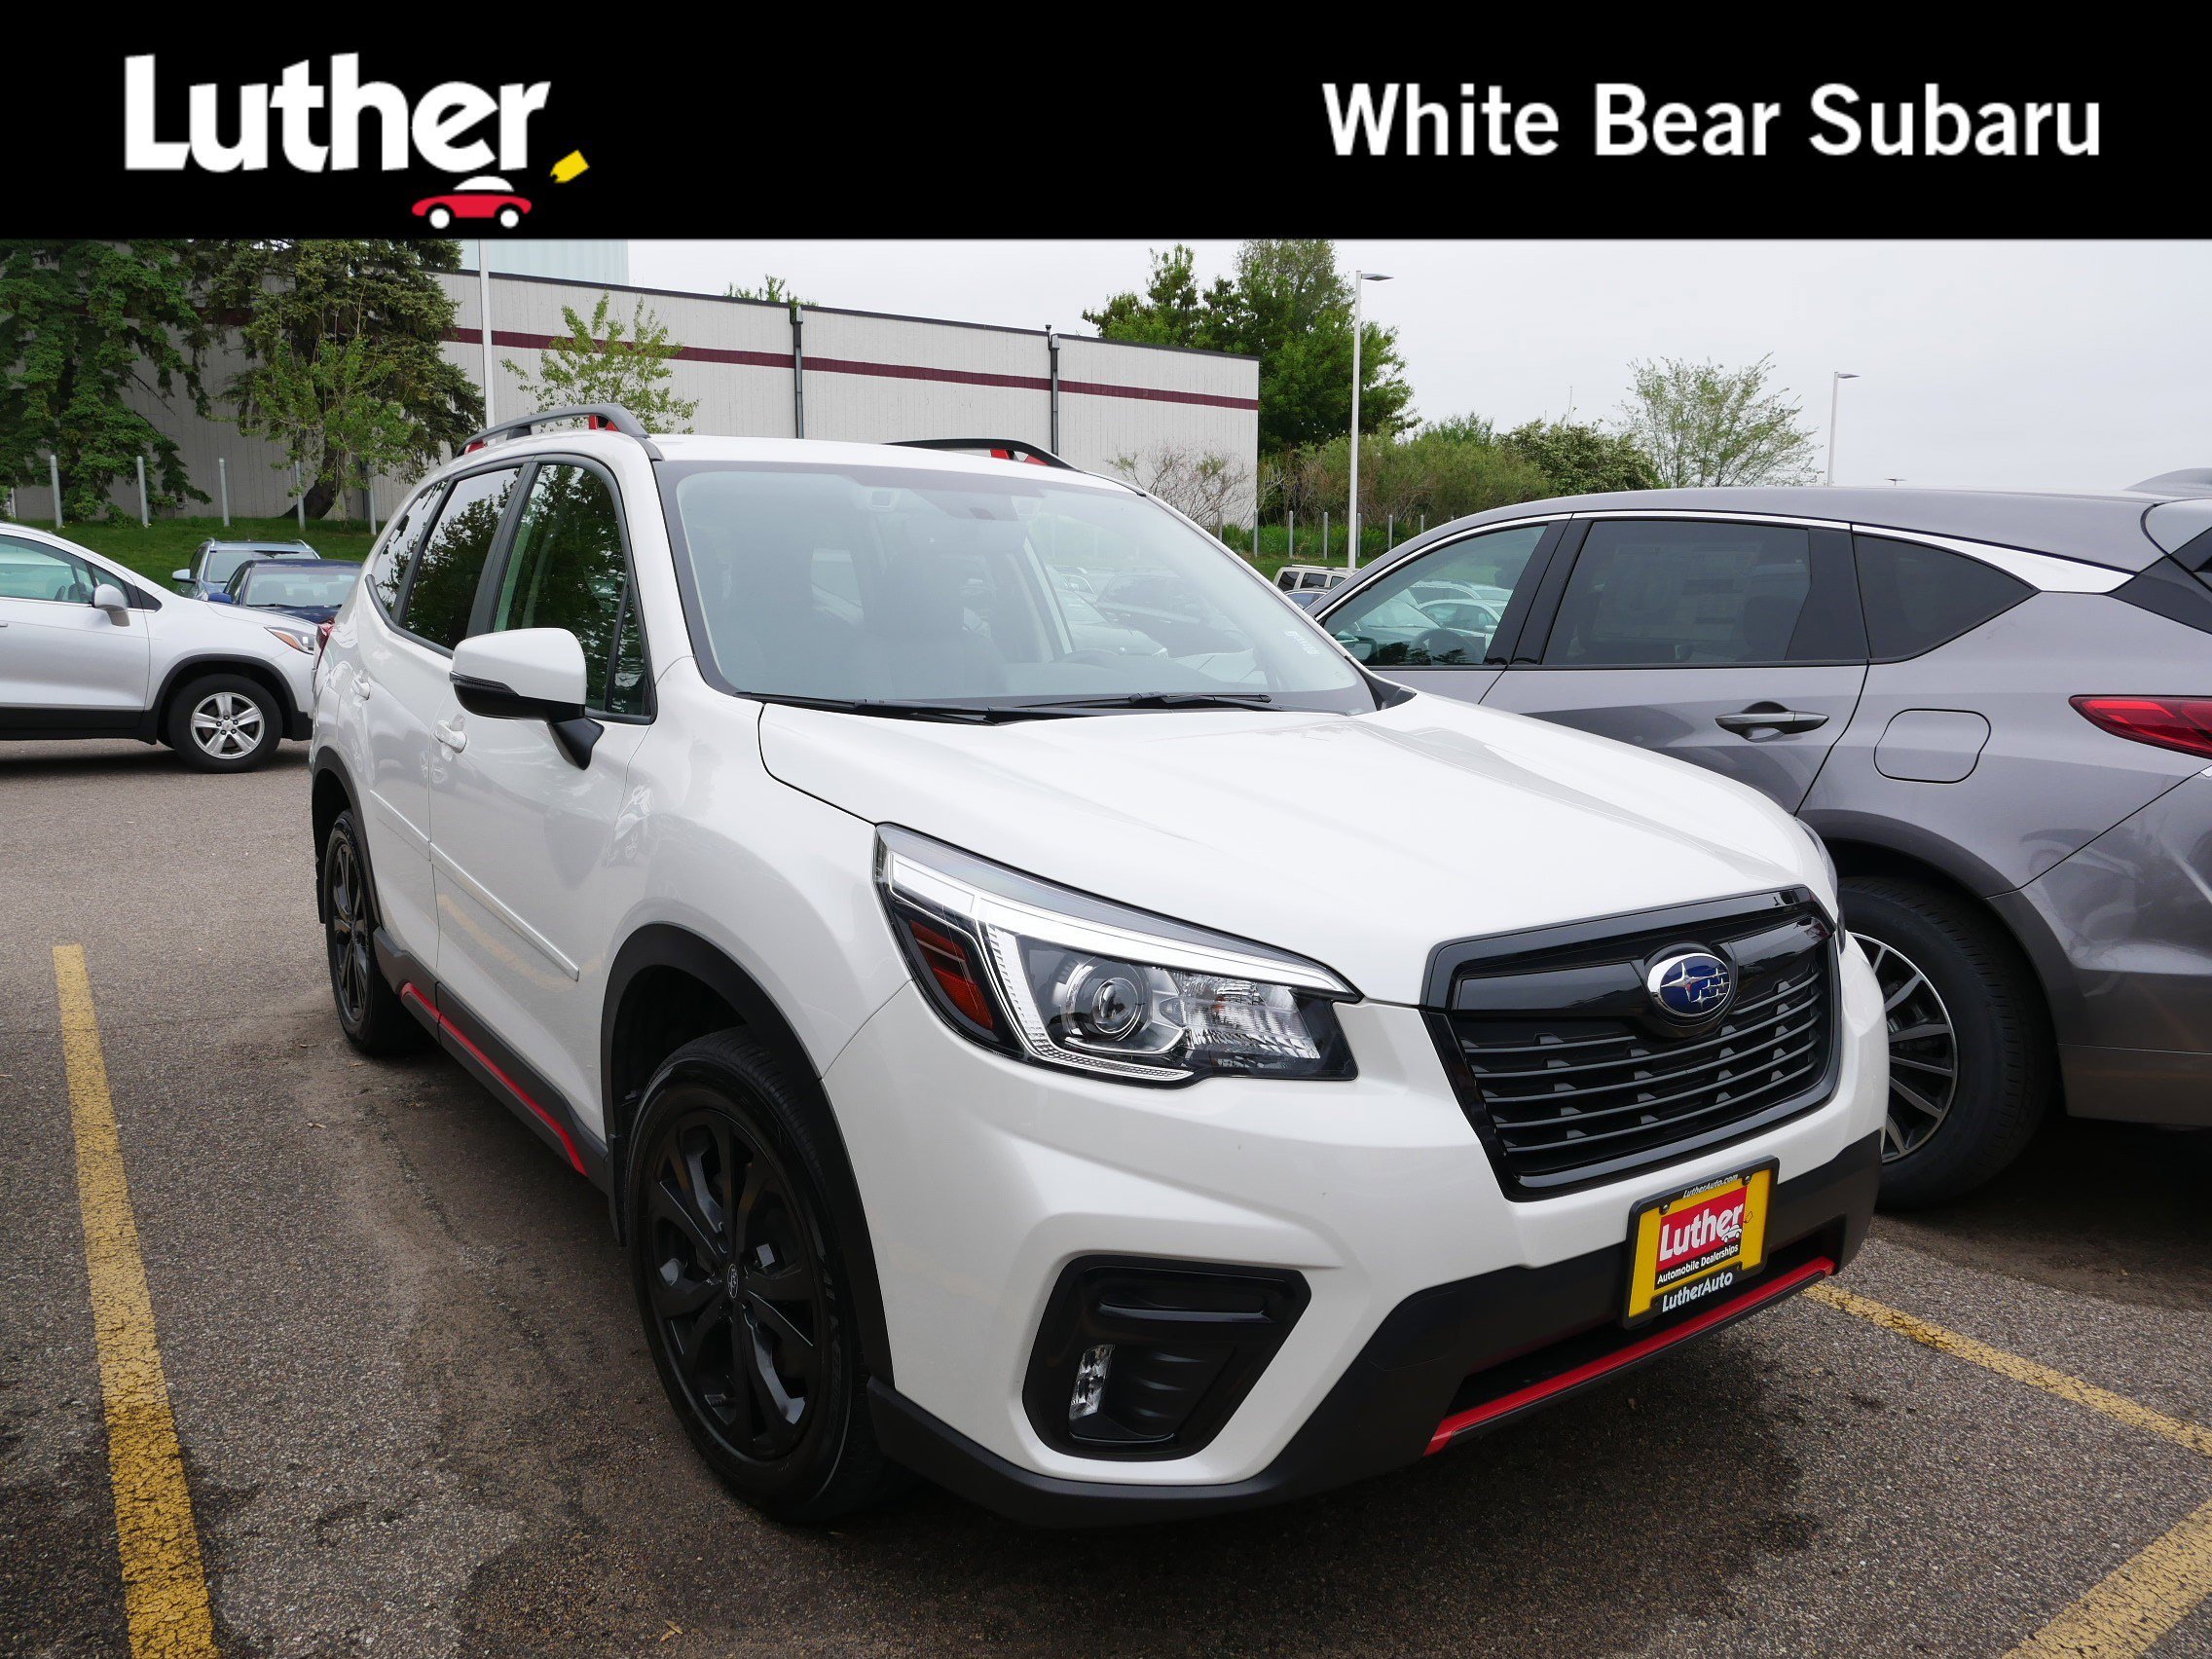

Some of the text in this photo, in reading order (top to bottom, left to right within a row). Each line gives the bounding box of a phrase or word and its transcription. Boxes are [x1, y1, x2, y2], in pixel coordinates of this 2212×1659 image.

[1682, 1174, 1739, 1199] LutherAuto.com
[1659, 1202, 1745, 1262] Luther
[1657, 1244, 1739, 1285] Automobile Dealerships
[1662, 1272, 1733, 1312] LutherAuto
